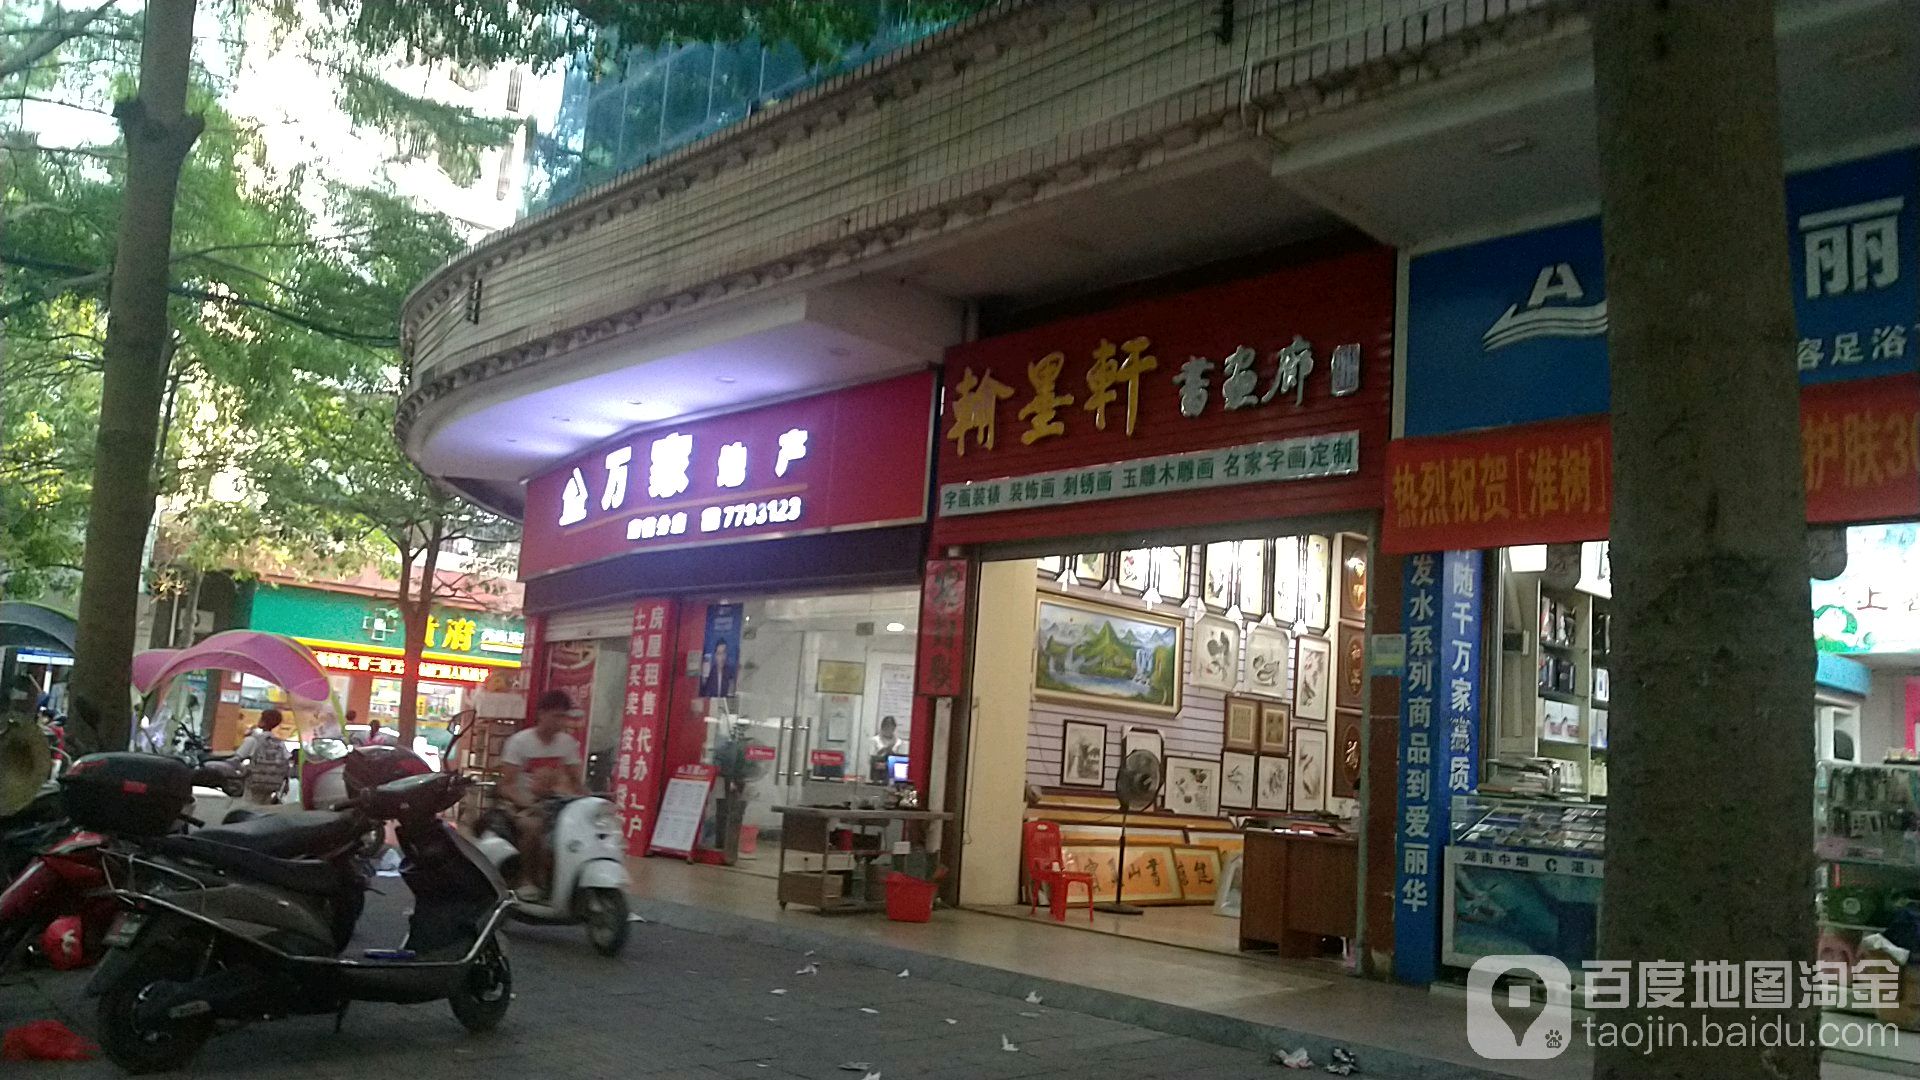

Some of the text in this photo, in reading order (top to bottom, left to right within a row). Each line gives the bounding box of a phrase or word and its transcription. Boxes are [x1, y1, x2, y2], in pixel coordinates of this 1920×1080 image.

[1798, 195, 1905, 299] 丽
[1222, 437, 1352, 478] 名家字画定制
